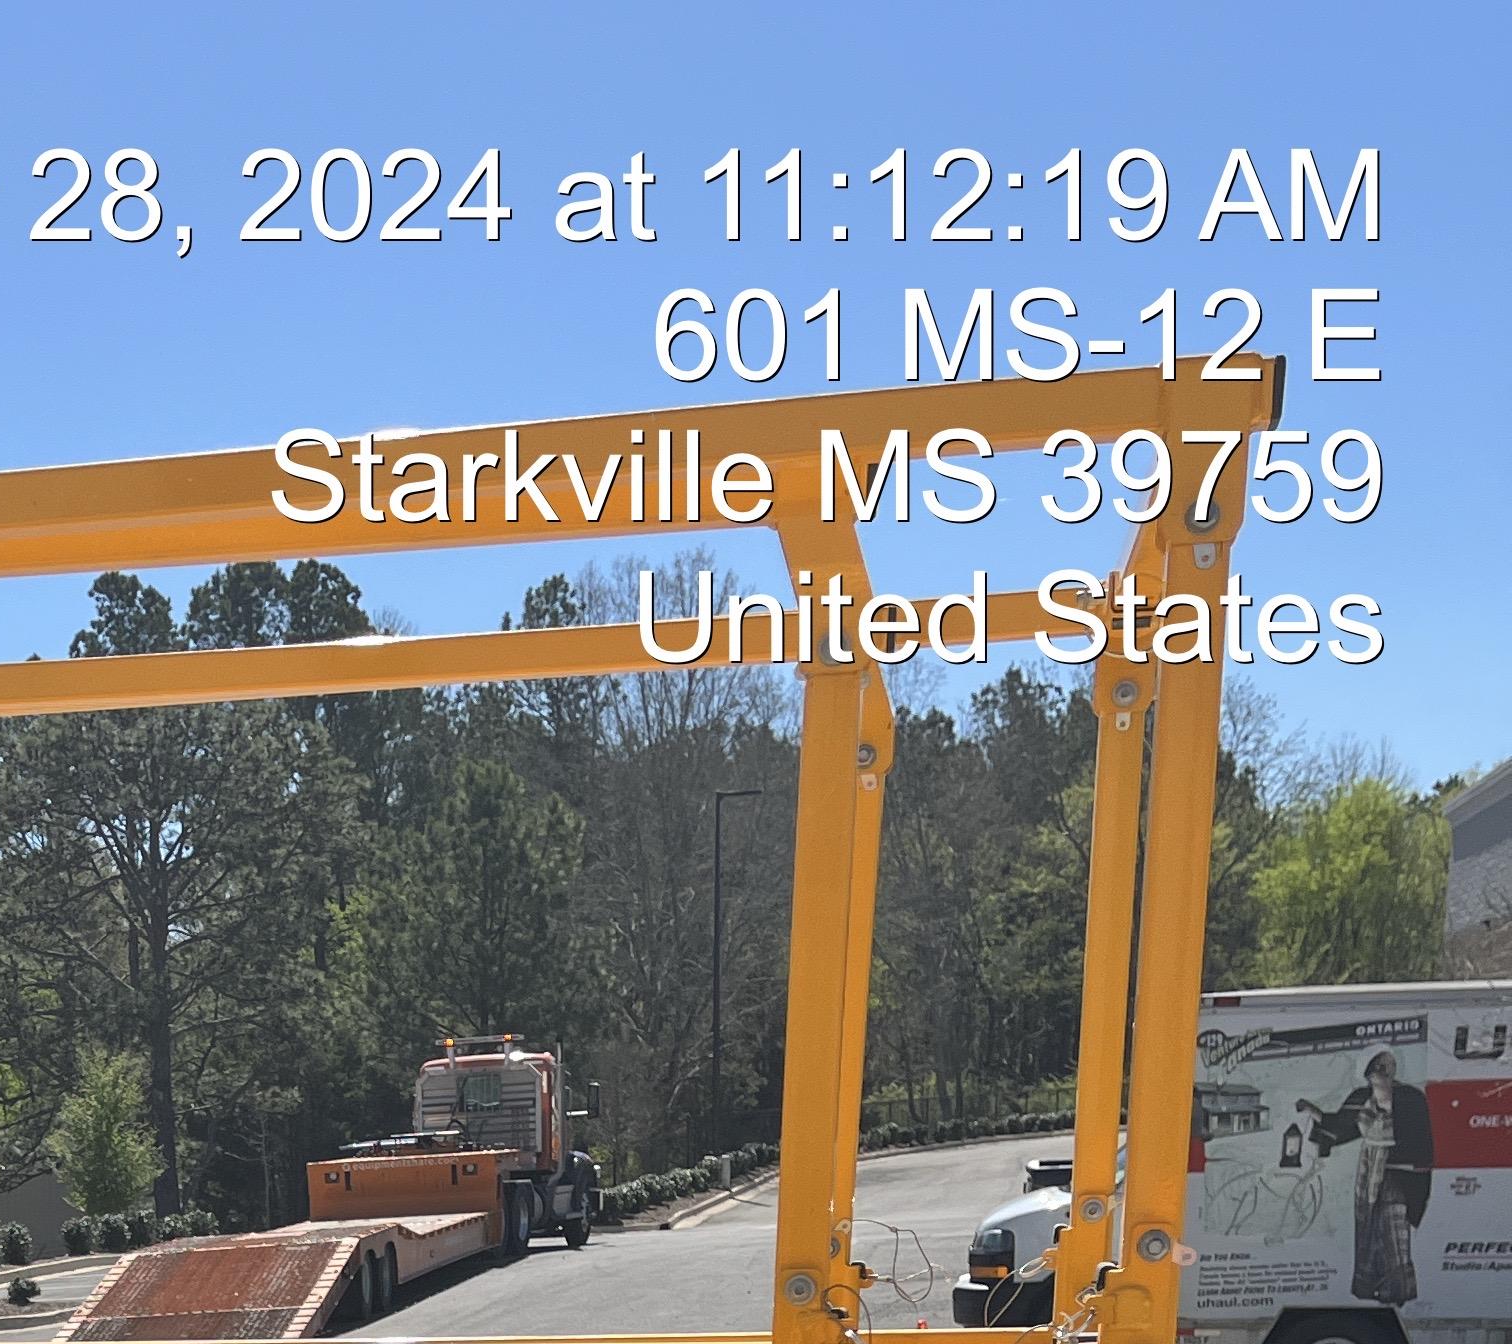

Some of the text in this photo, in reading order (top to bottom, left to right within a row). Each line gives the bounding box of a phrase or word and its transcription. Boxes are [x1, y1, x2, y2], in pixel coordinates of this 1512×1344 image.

[1355, 1020, 1420, 1036] ONTARIO
[1444, 1242, 1512, 1254] PERFE
[1197, 1297, 1274, 1309] uhaul.com
